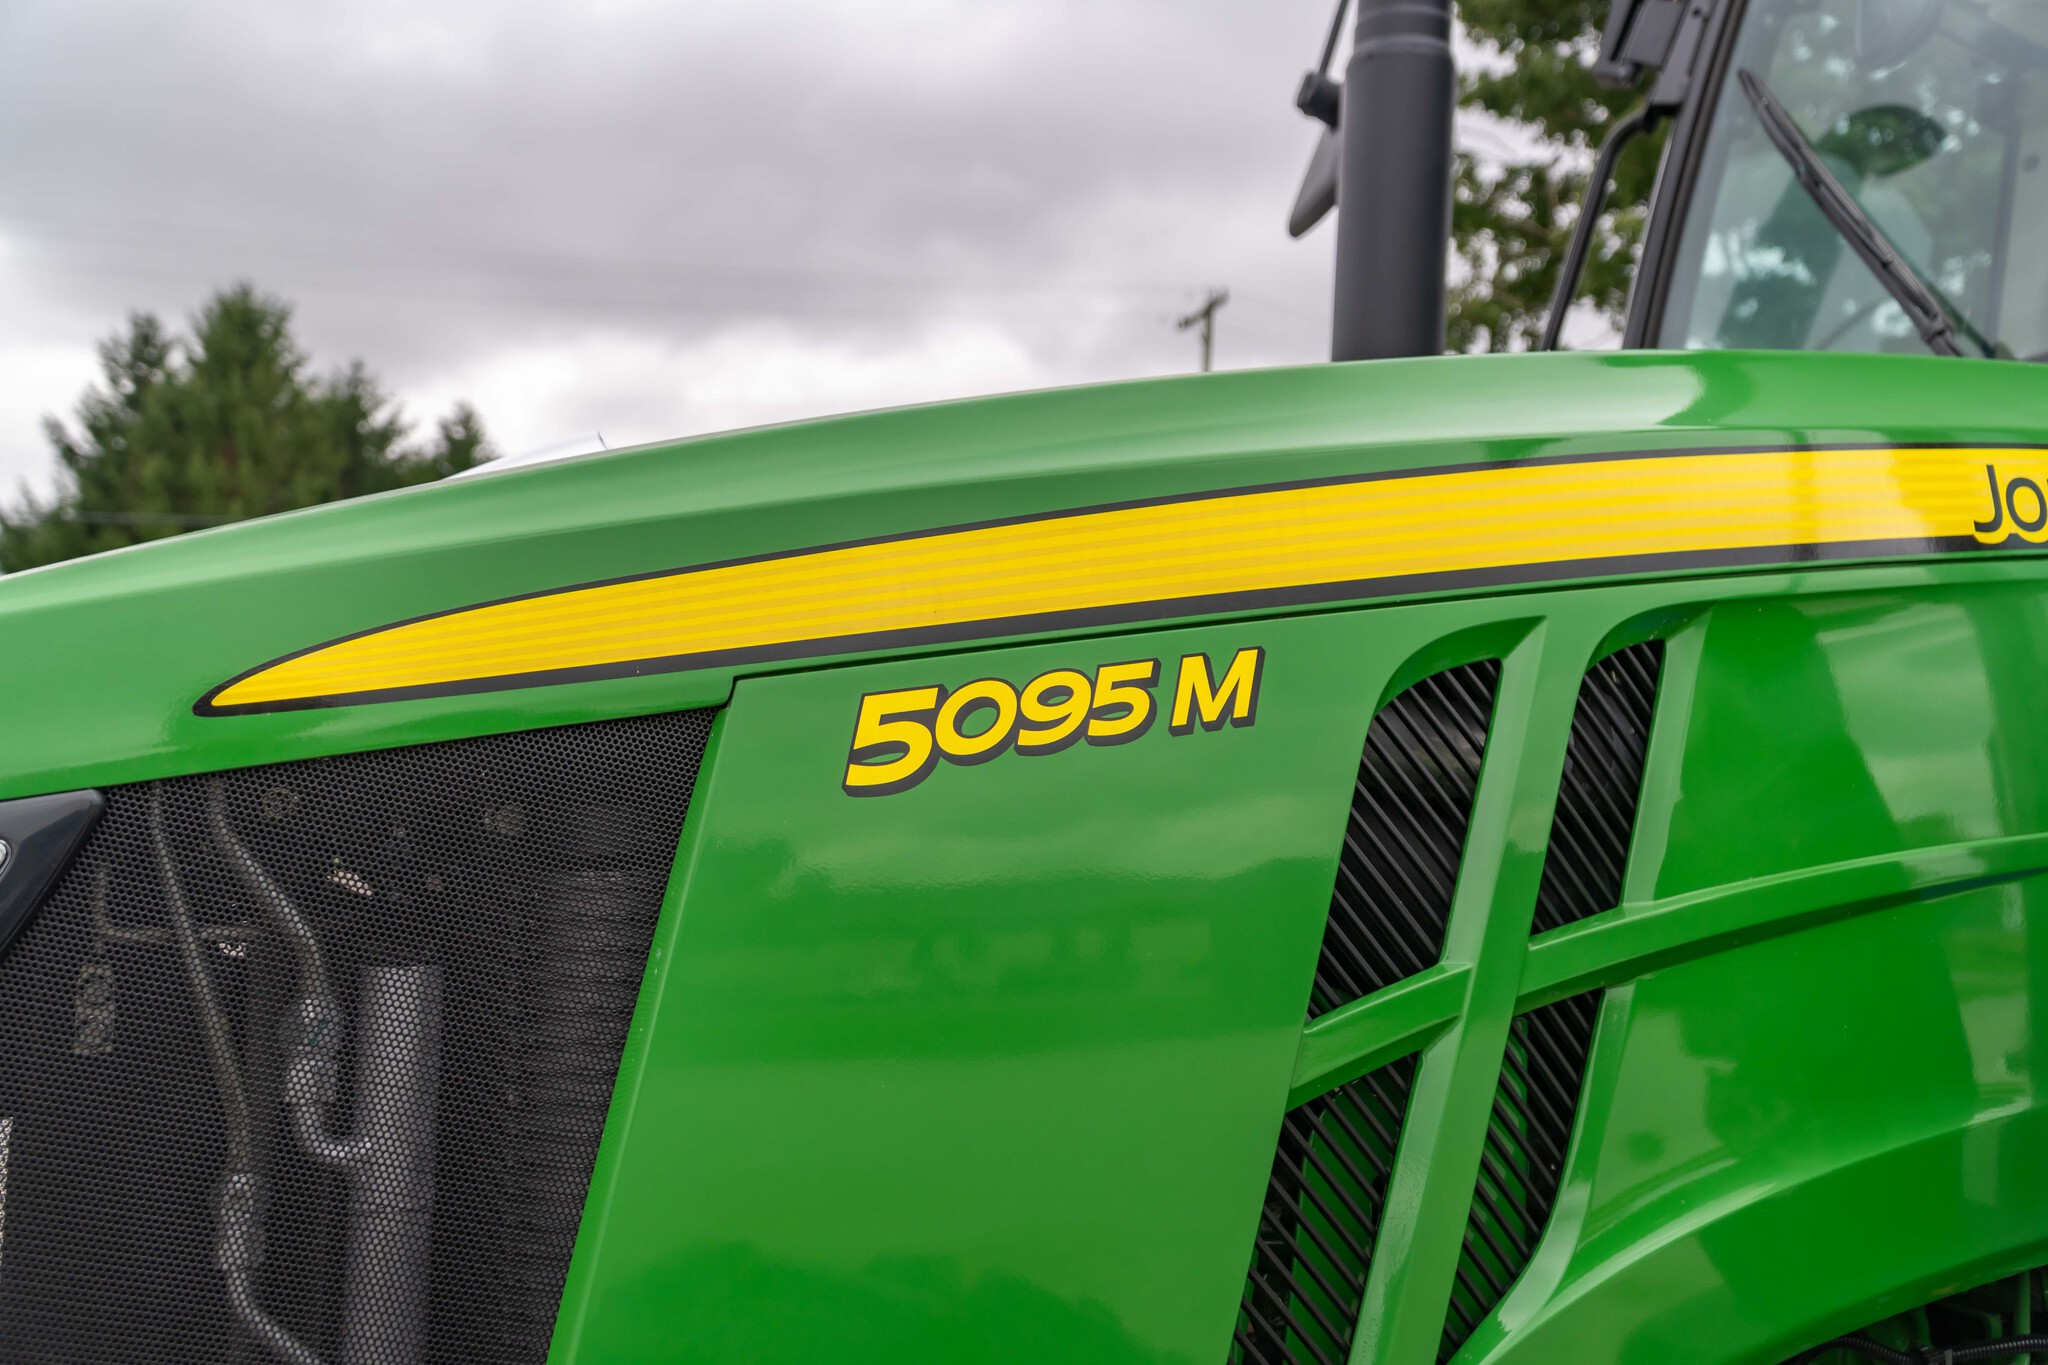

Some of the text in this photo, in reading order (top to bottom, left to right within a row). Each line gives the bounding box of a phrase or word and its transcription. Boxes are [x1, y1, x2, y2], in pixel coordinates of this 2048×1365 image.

[1973, 464, 2048, 533] JO
[842, 646, 1266, 797] 5095 M
